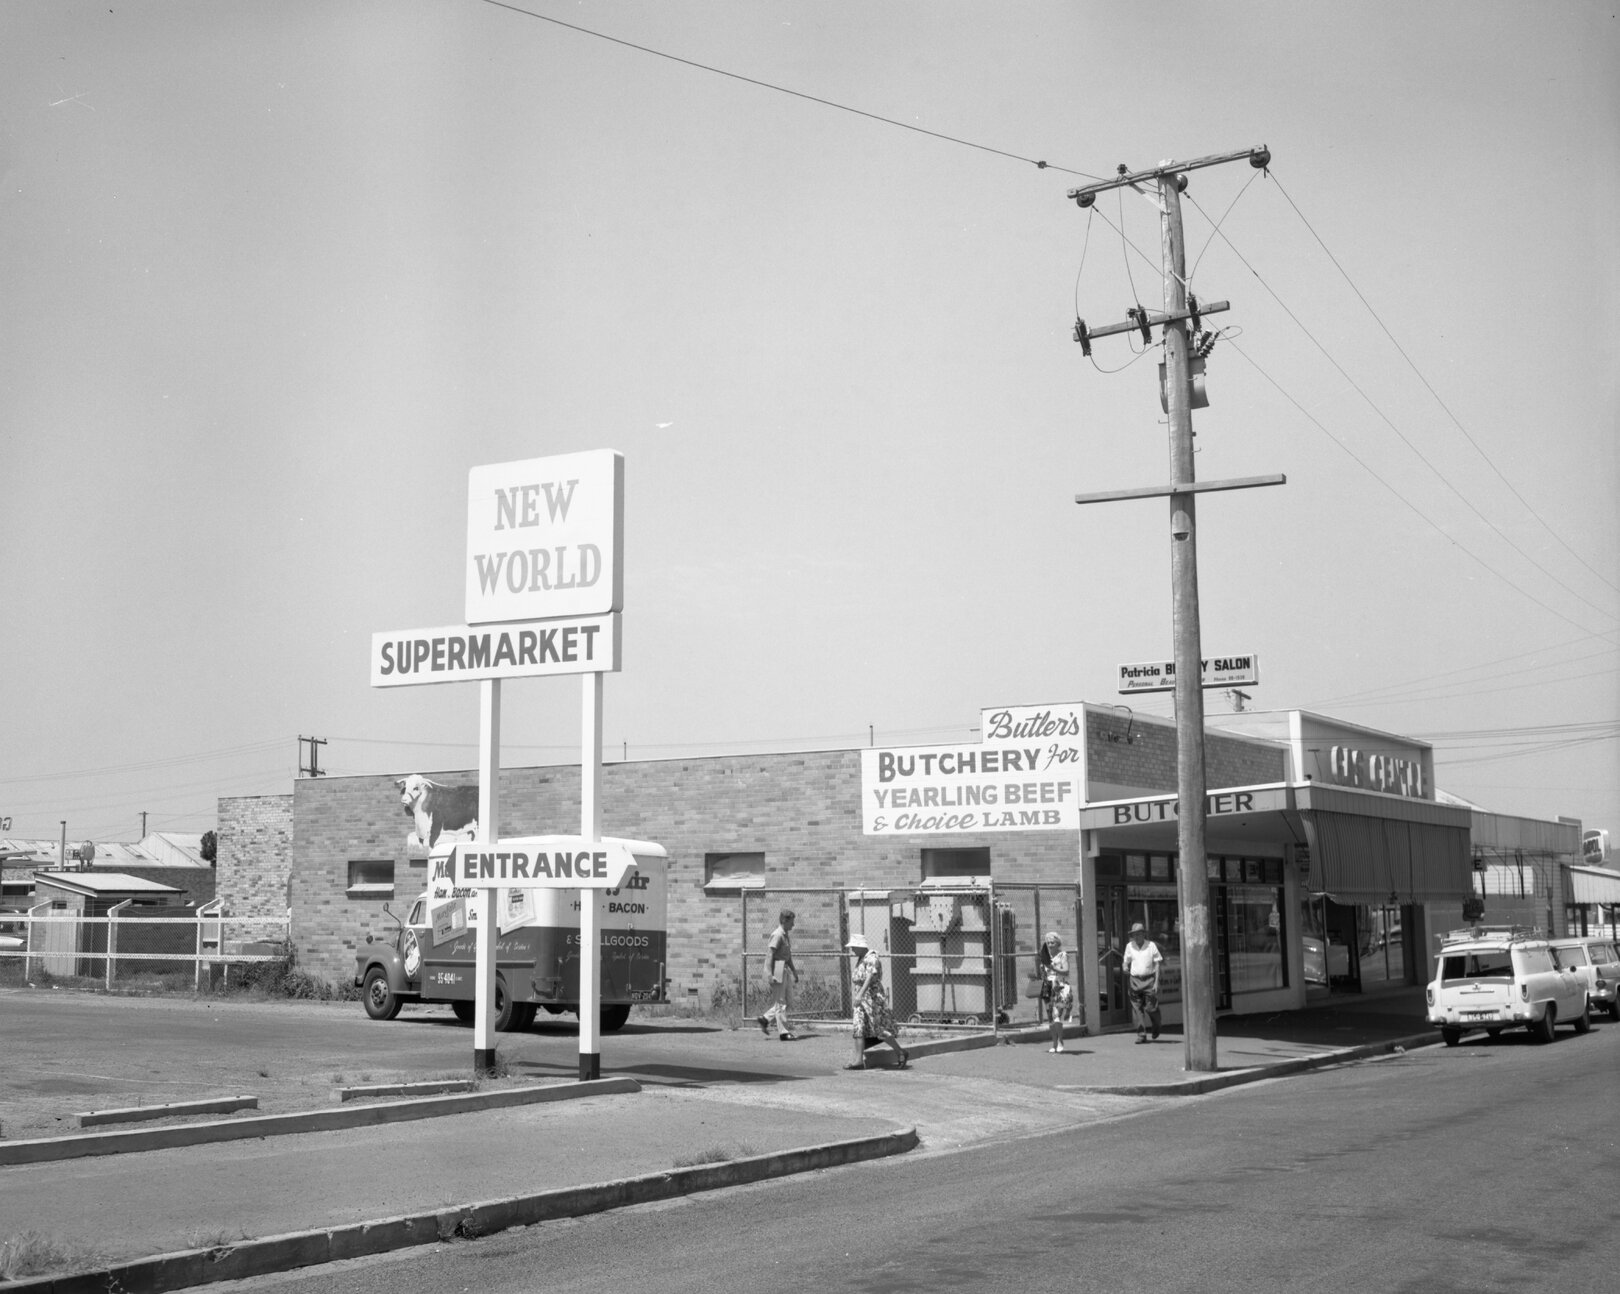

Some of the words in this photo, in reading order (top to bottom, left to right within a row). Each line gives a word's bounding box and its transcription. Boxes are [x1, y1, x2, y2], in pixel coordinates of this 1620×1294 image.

[494, 479, 580, 531] NEW
[474, 543, 602, 597] WORLD
[380, 625, 600, 675] SUPERMARKET
[1121, 665, 1160, 678] Patricia
[1214, 657, 1250, 671] SALON
[987, 709, 1080, 739] Butler's
[878, 748, 1041, 783] BUTCHERY
[873, 785, 998, 809] YEARLING
[1004, 781, 1072, 804] BEEF
[873, 815, 889, 831] &
[894, 812, 978, 830] Choice
[982, 809, 1061, 827] LAMB
[463, 851, 608, 879] ENTRANCE
[608, 902, 645, 914] BACON
